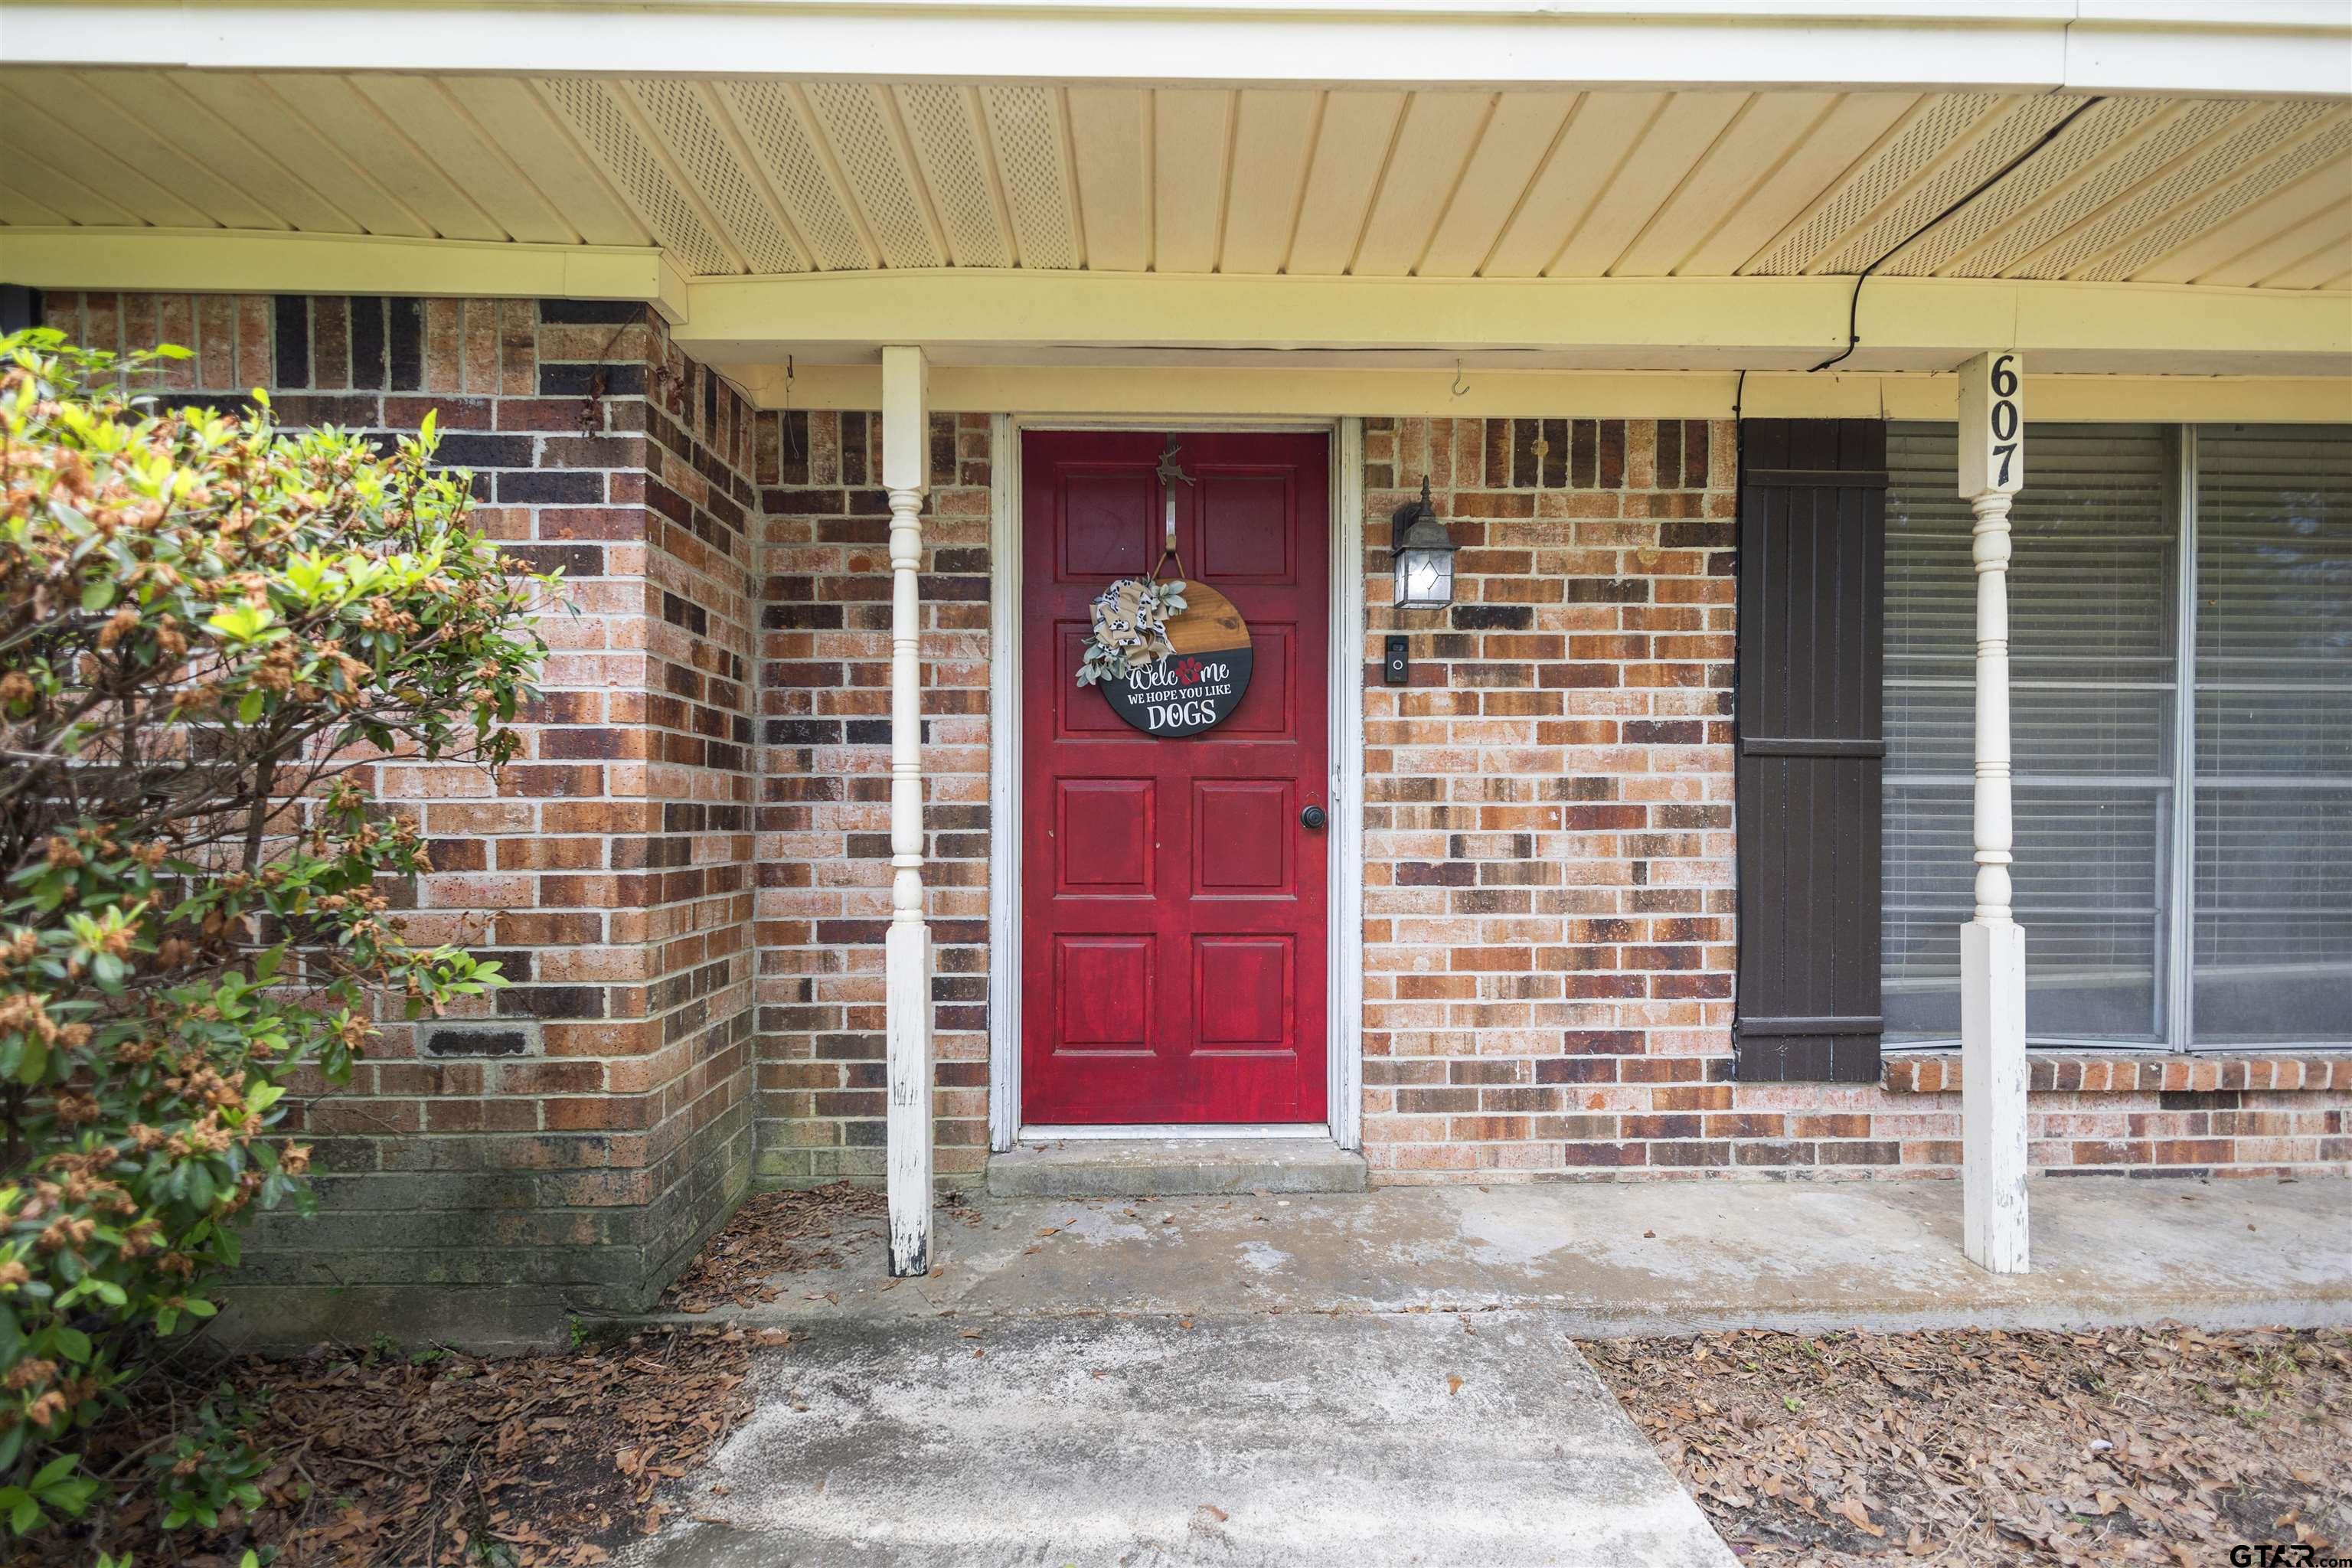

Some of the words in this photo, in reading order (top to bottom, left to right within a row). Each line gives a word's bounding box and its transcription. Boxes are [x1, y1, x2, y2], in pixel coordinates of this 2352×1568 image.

[1991, 354, 2017, 487] 607
[1125, 659, 1230, 690] Welcme
[1128, 693, 1145, 705] WE
[1146, 690, 1178, 703] HOPE
[1179, 687, 1202, 699] YOU
[1205, 684, 1232, 697] LIKE
[1147, 699, 1217, 730] DOGS
